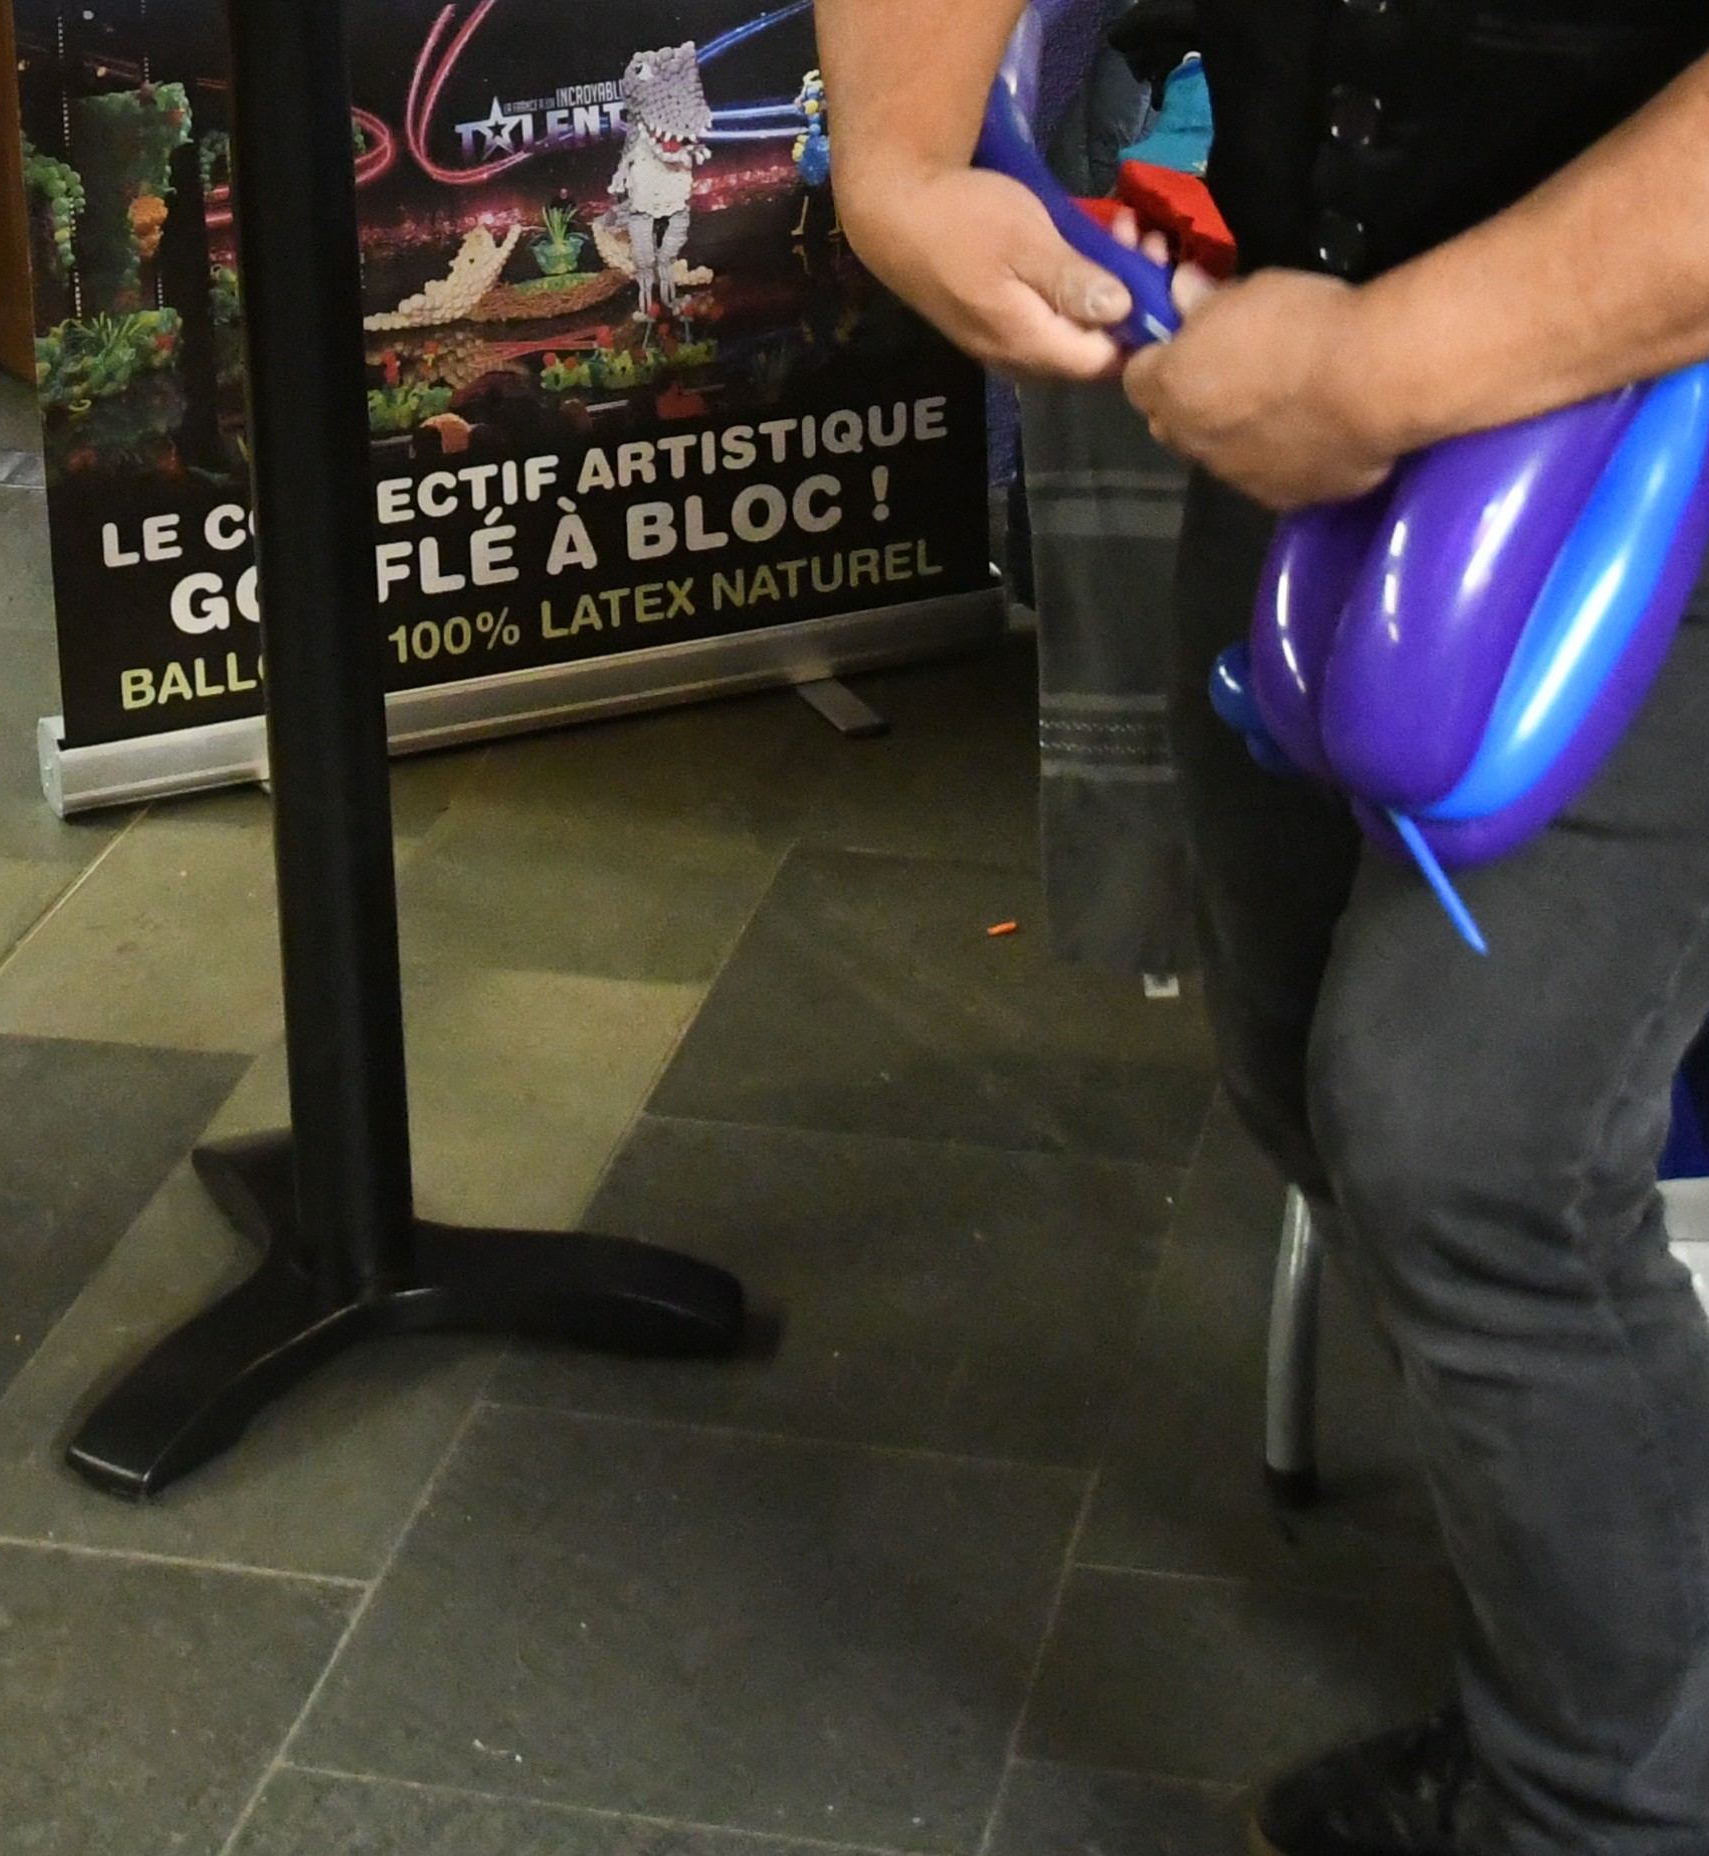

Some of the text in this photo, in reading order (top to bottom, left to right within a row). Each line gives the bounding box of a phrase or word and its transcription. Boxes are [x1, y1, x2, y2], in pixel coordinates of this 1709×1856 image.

[102, 396, 948, 567] LE CECTIF ARTISTIQUE
[170, 506, 520, 634] GFLÉ
[546, 497, 597, 576] À
[626, 473, 843, 562] BLOC
[121, 538, 944, 711] BALL 100% LATEX NATUREL
